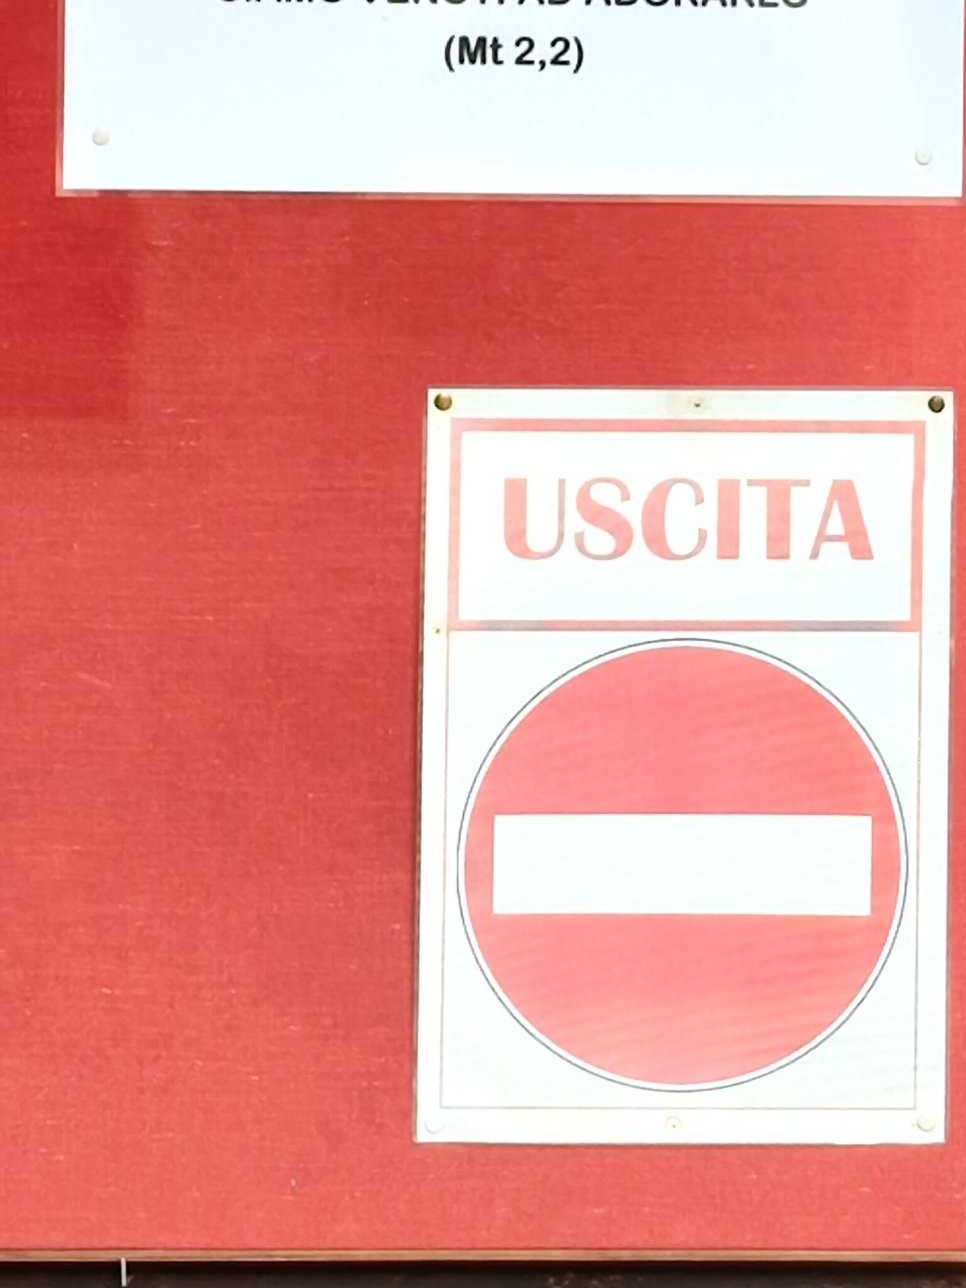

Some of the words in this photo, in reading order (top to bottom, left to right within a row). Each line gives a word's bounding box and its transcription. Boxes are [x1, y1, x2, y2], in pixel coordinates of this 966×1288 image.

[444, 34, 504, 73] (Mt
[514, 36, 584, 74] 2,2)
[502, 476, 875, 562] USCITA
